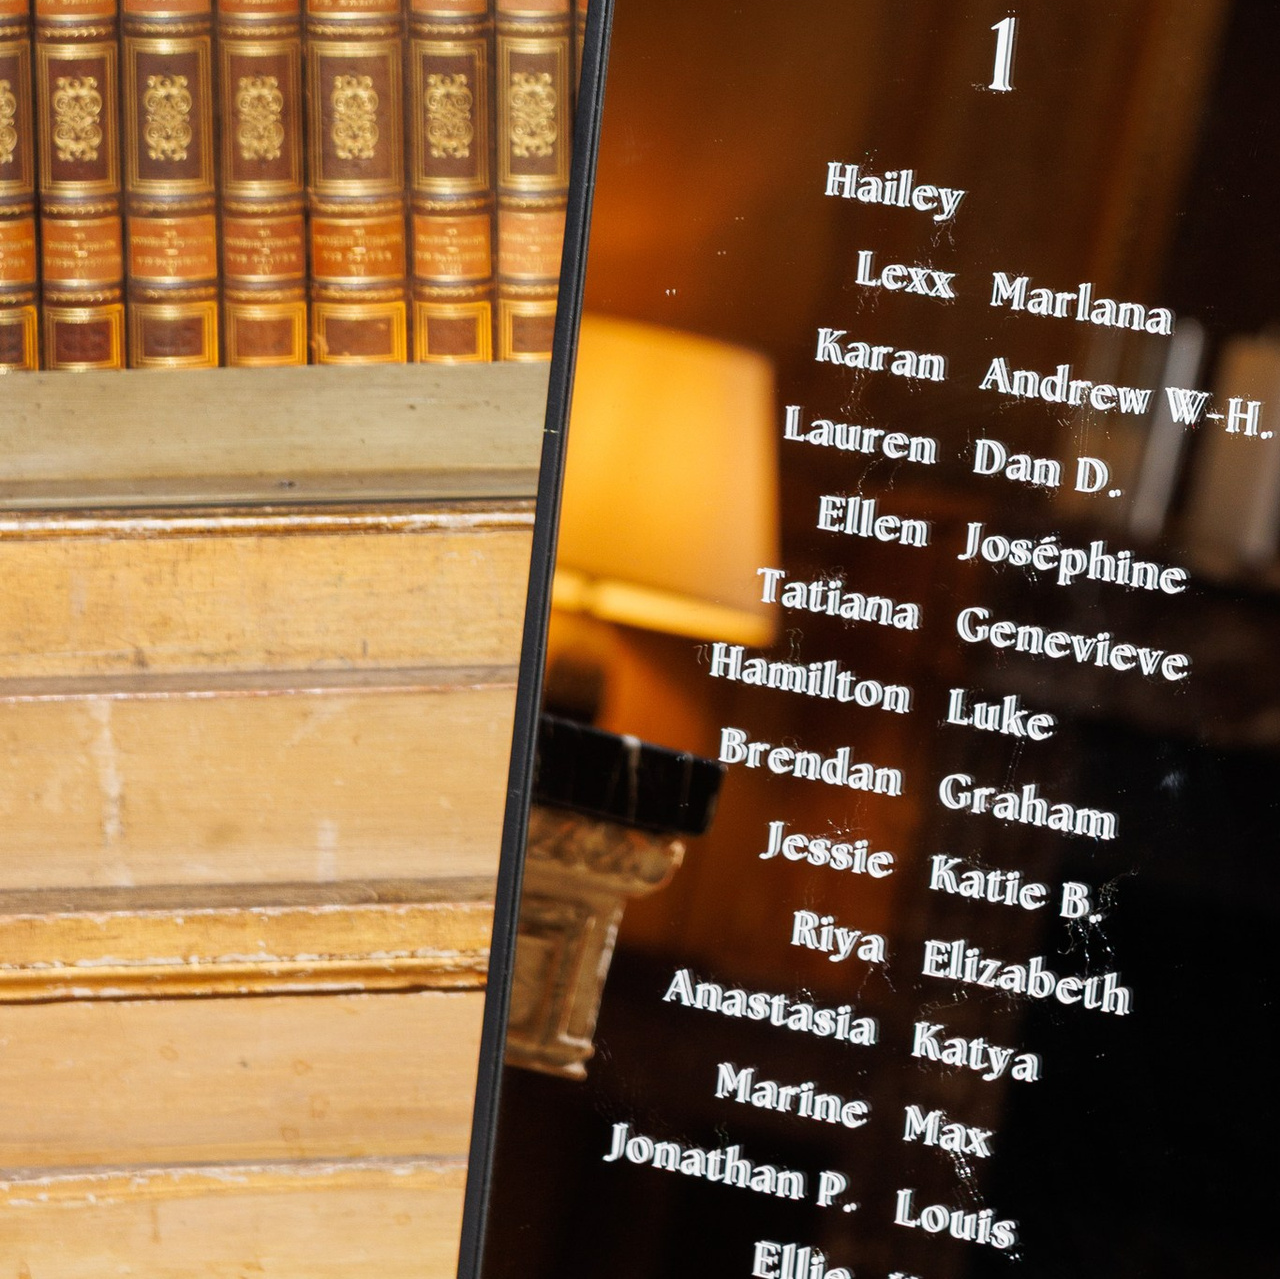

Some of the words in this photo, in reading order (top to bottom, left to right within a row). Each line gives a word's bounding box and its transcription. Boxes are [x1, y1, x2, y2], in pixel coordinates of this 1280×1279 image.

[989, 18, 1015, 91] 1
[825, 162, 965, 221] Hailey
[855, 251, 955, 298] Lexx
[815, 328, 944, 381] Karan
[979, 358, 1152, 414] Andrew
[1165, 387, 1273, 439] W-H.
[784, 406, 935, 464] Lauren
[973, 439, 1060, 487] Dan
[1075, 457, 1121, 497] D.
[817, 496, 927, 547] Ellen
[958, 522, 1186, 594] Joséphine
[757, 568, 918, 630] Tatiana
[957, 607, 1188, 680] Genevieve
[710, 643, 909, 713] Hamilton
[947, 689, 1053, 740] Luke
[719, 728, 901, 796] Brendan
[940, 774, 1115, 840] Graham
[760, 821, 893, 878] Jessie
[930, 855, 1046, 910] Katie
[1060, 882, 1102, 923] B.
[791, 910, 885, 963] Riya
[663, 969, 875, 1045] Anastasia
[922, 940, 1129, 1015] Elizabeth
[912, 1022, 1038, 1082] Katya
[715, 1063, 867, 1128] Marine
[903, 1105, 992, 1158] Max
[604, 1123, 804, 1199] Jonathan
[817, 1171, 856, 1212] P.
[895, 1189, 1017, 1248] Louis
